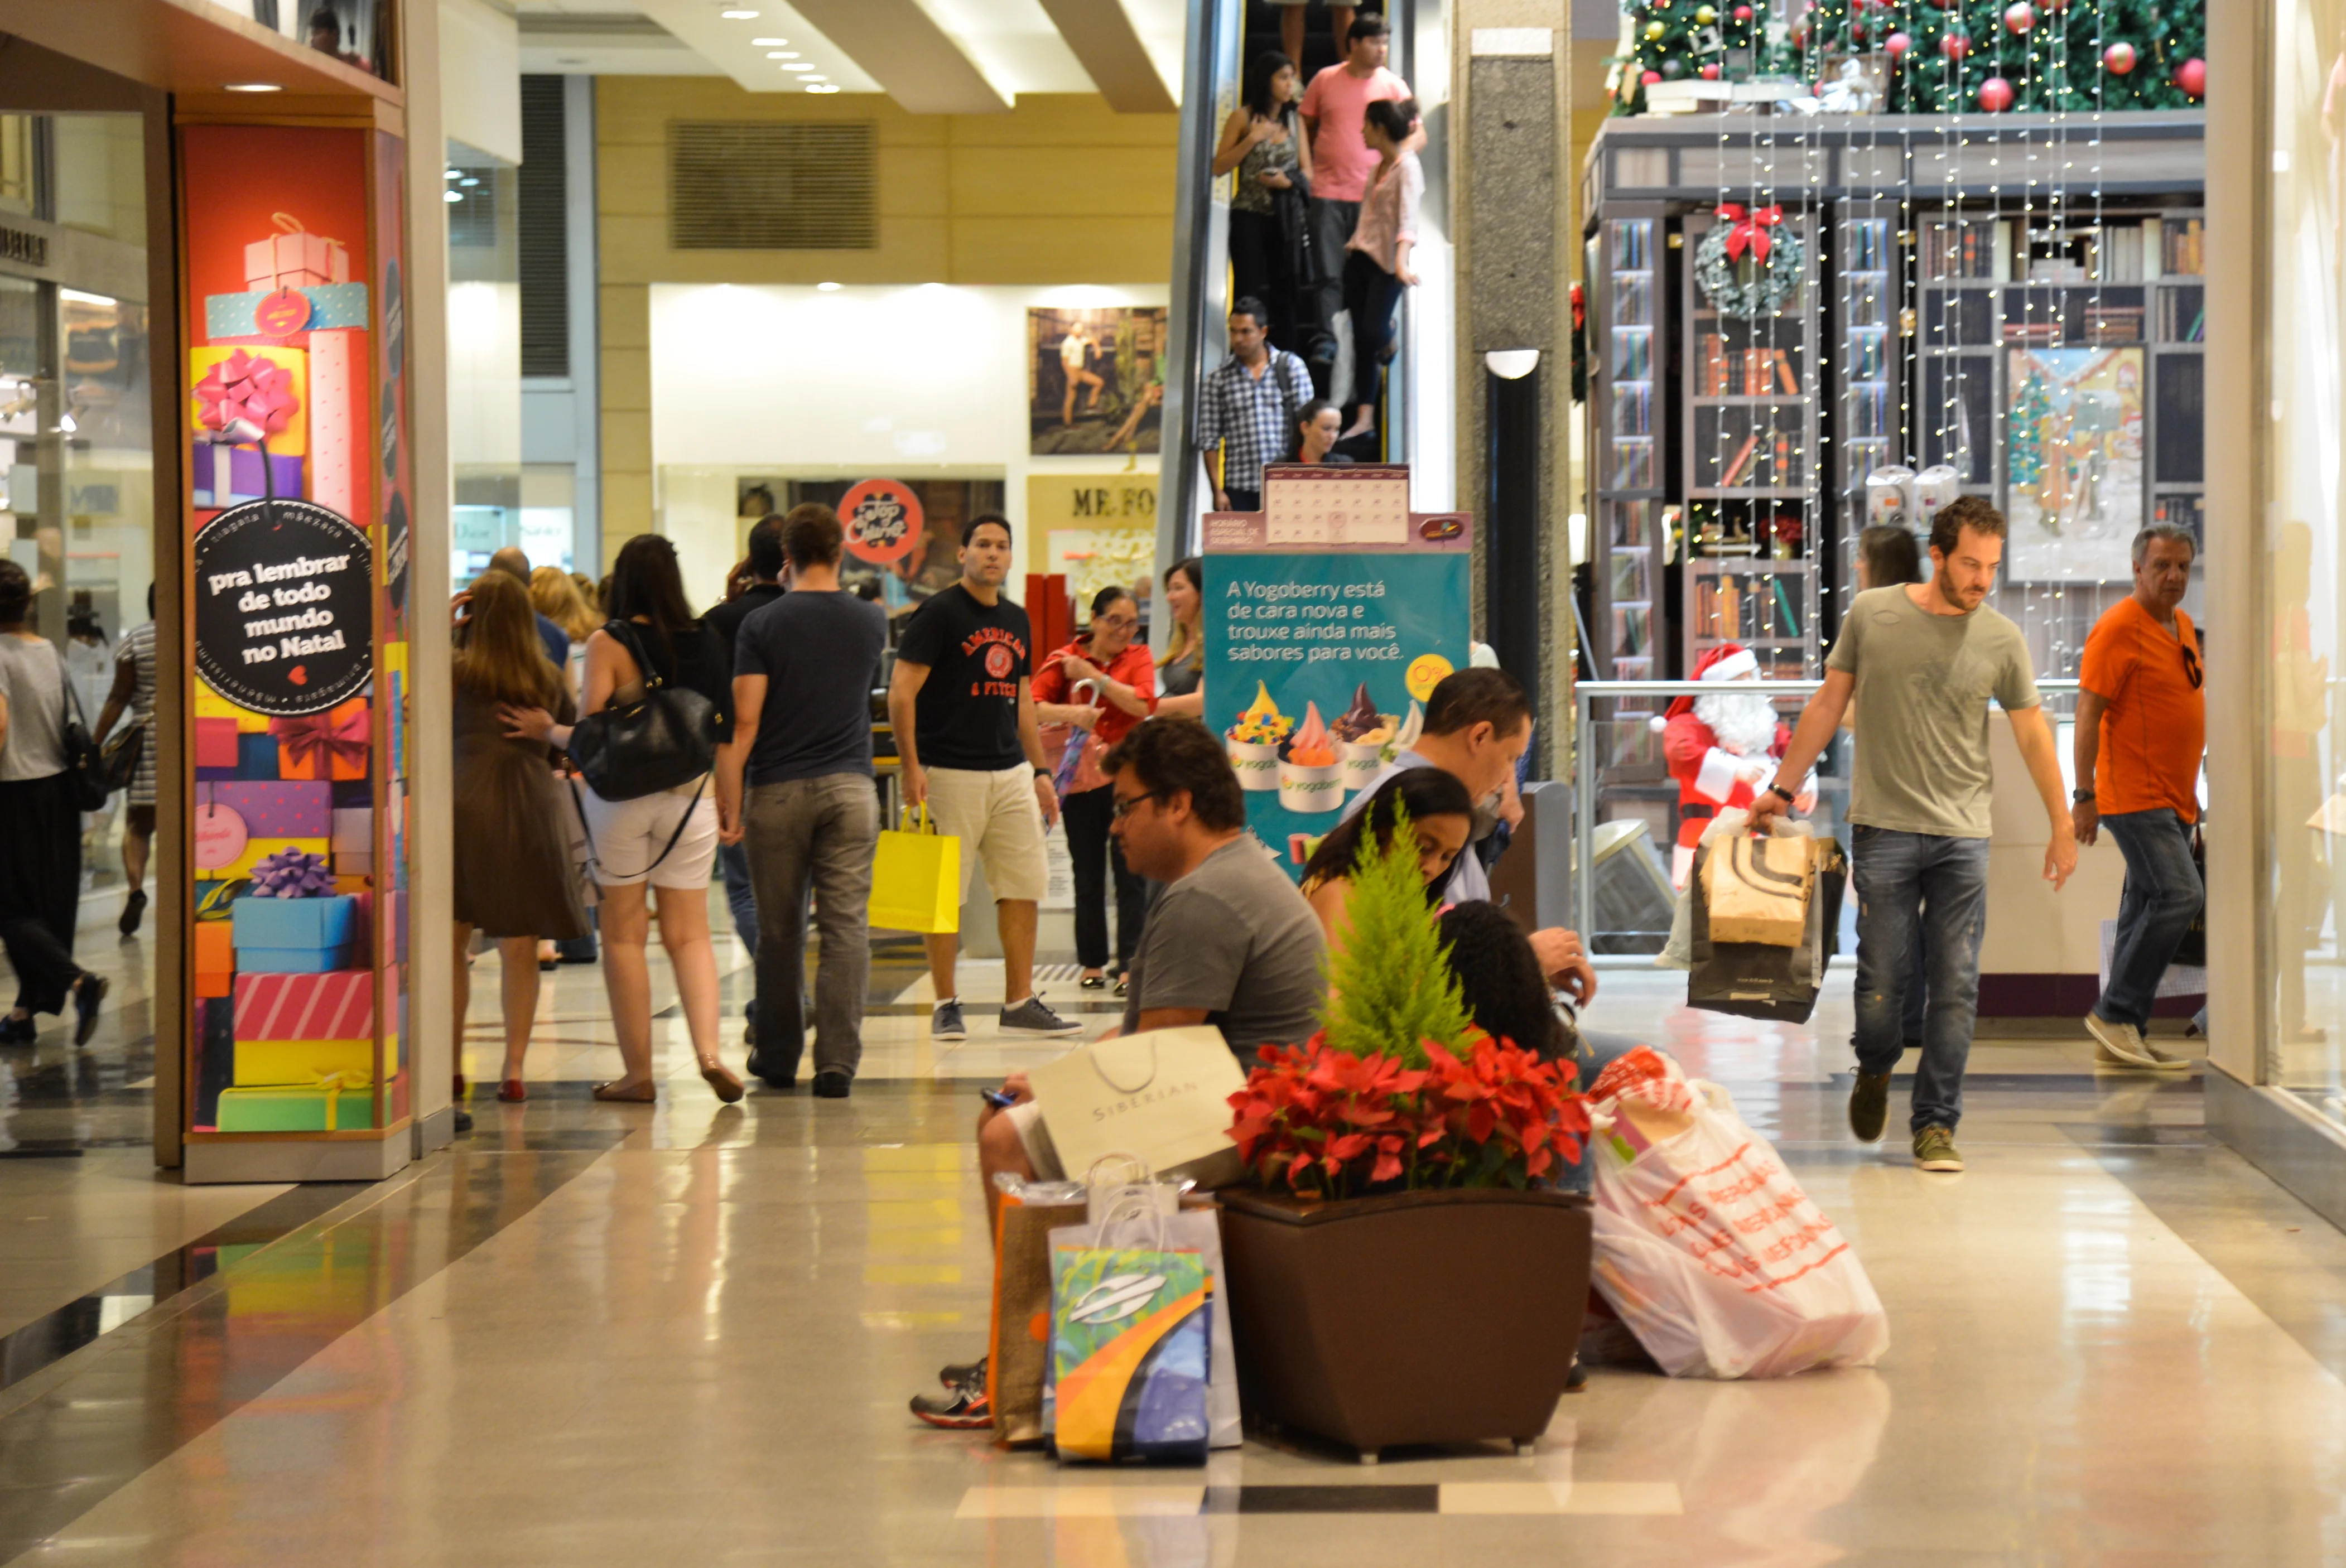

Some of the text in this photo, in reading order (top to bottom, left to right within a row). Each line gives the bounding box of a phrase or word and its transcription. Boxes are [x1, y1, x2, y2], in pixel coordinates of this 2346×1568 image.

[208, 568, 253, 596] pra
[253, 553, 351, 584] lembrar
[238, 581, 332, 613] de todo
[1227, 580, 1386, 602] A Yogoberry está
[243, 607, 334, 638] mundo
[1227, 602, 1365, 620] de cara nova e
[1227, 623, 1396, 640] trouxe ainda mais
[241, 644, 277, 665] no
[280, 629, 346, 659] Natal
[1227, 643, 1404, 665] sabores para você.
